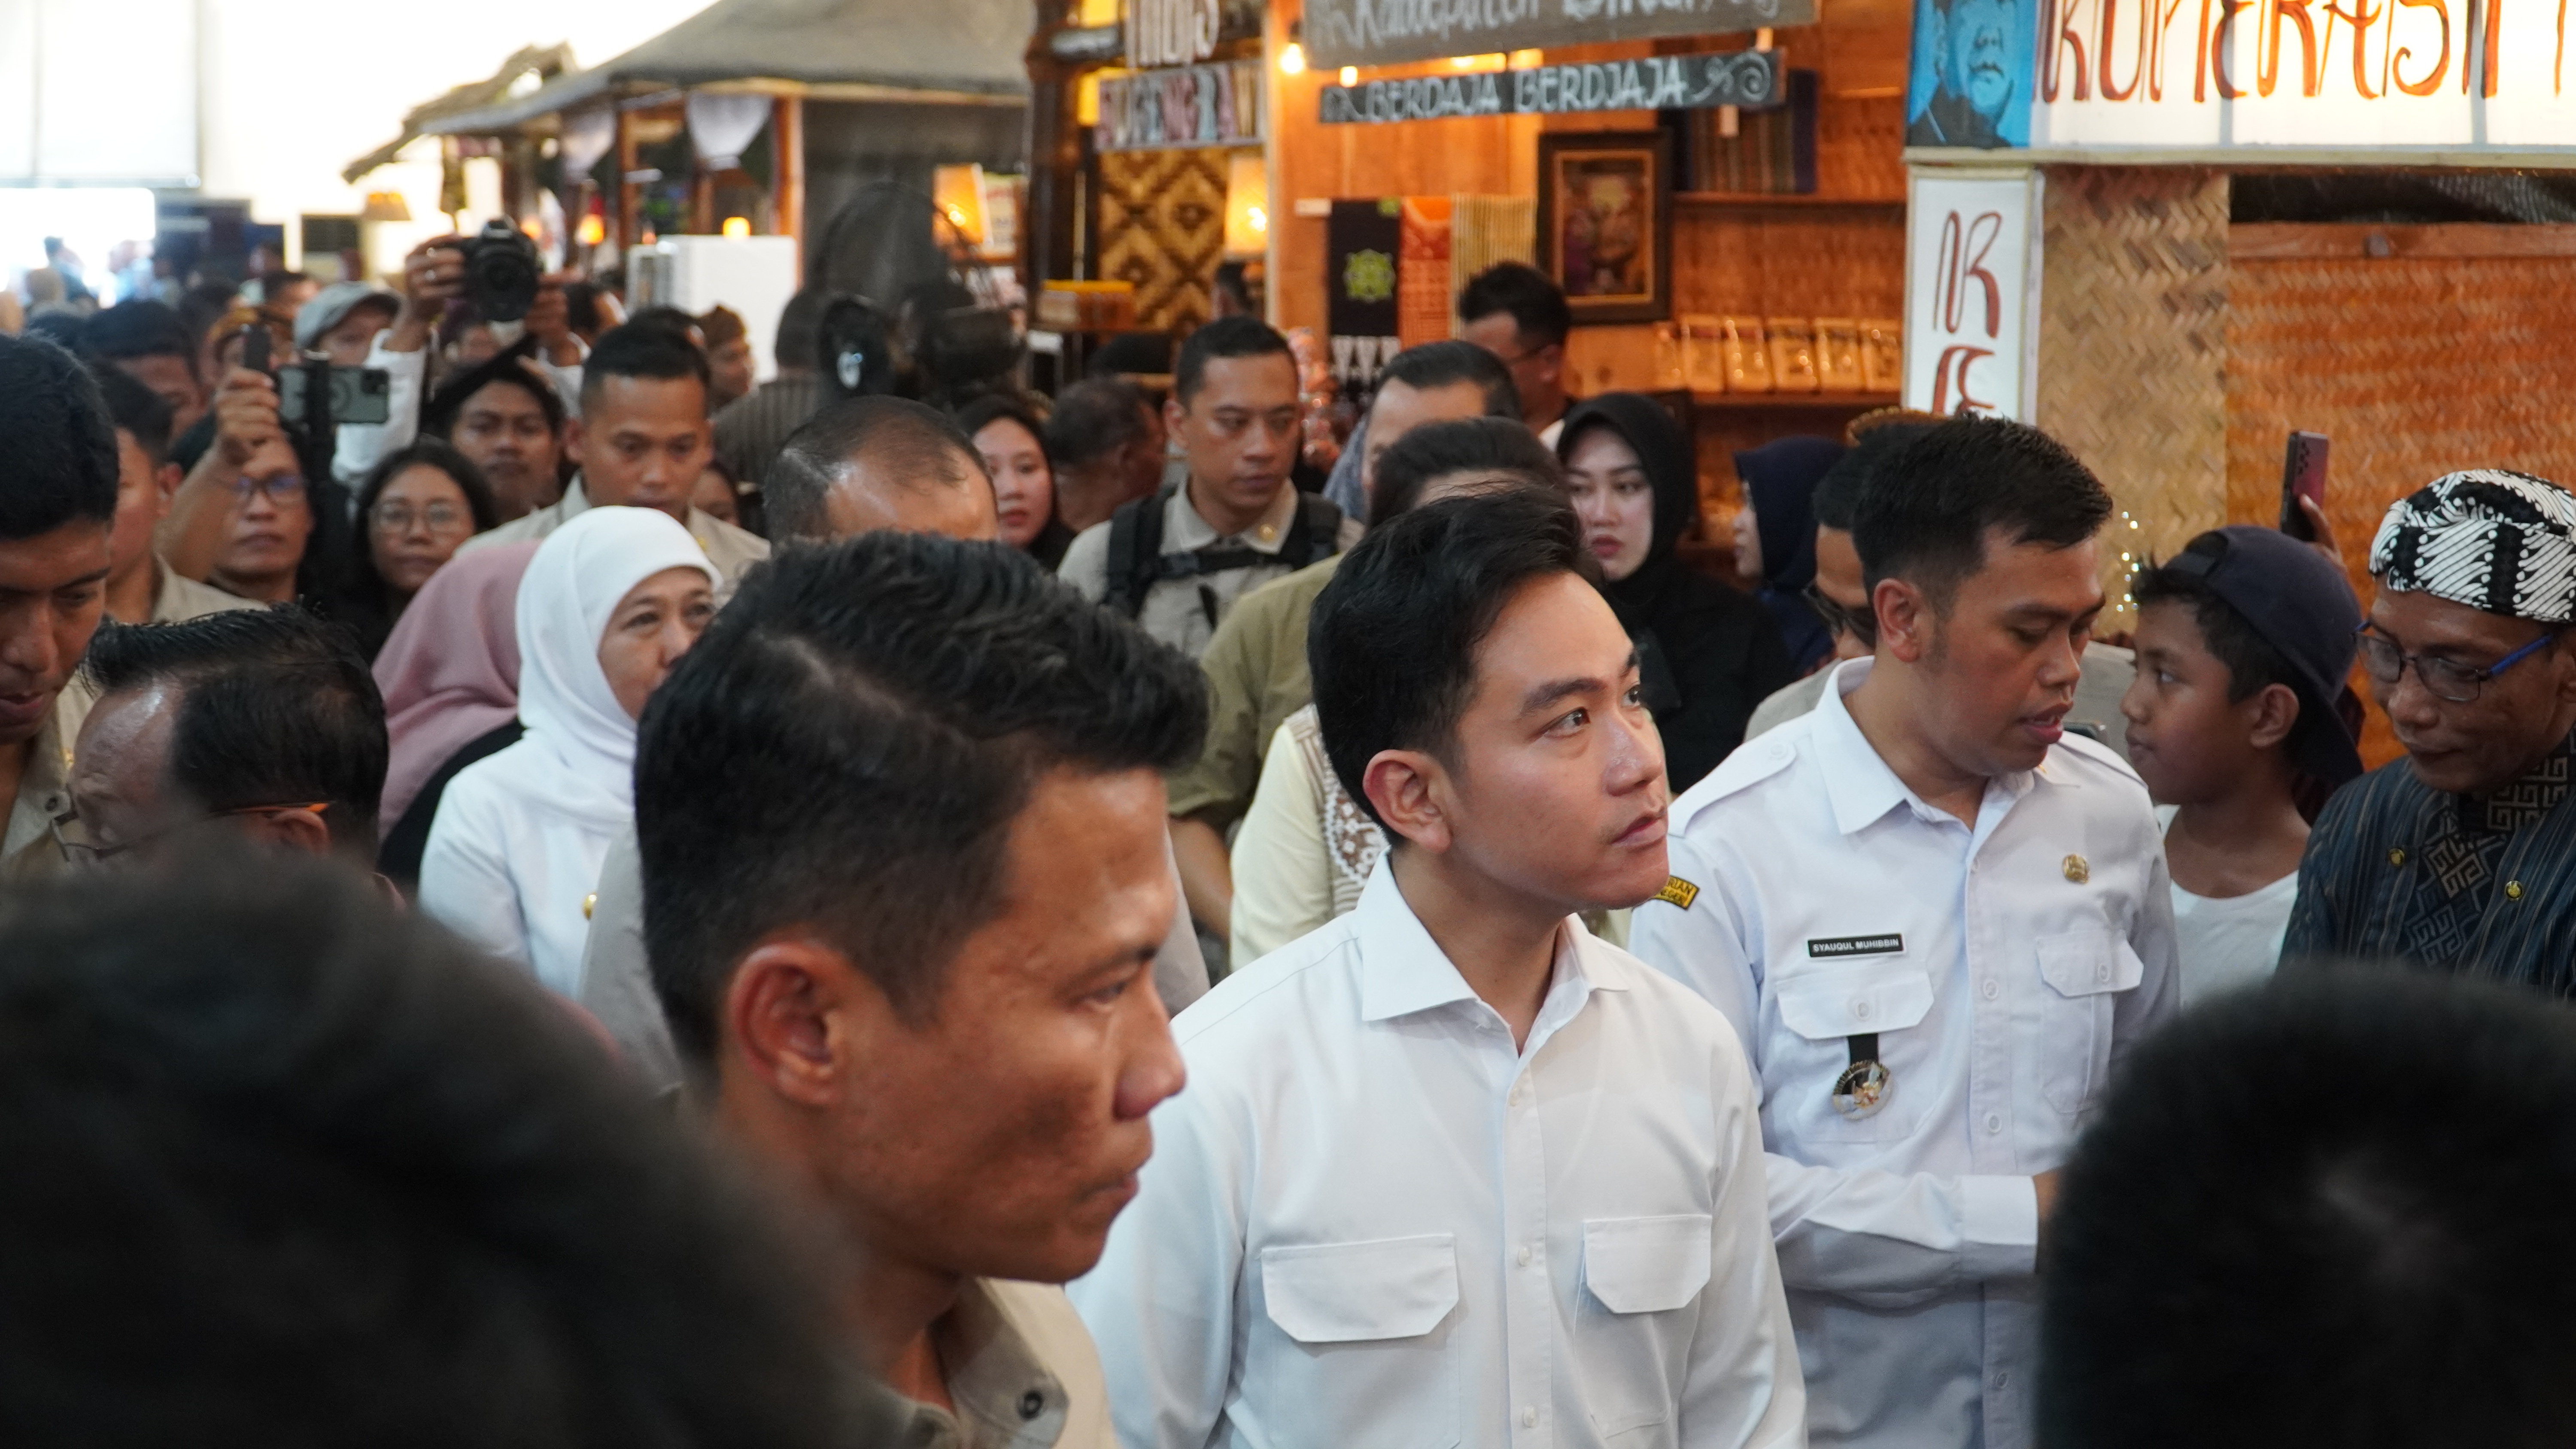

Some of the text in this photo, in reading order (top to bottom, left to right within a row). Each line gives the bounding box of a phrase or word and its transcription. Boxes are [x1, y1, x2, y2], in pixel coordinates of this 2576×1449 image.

[1366, 56, 1689, 123] BERDAJA BERDJAJA
[1812, 938, 1899, 953] SYAUQUL MUHIBBIN
